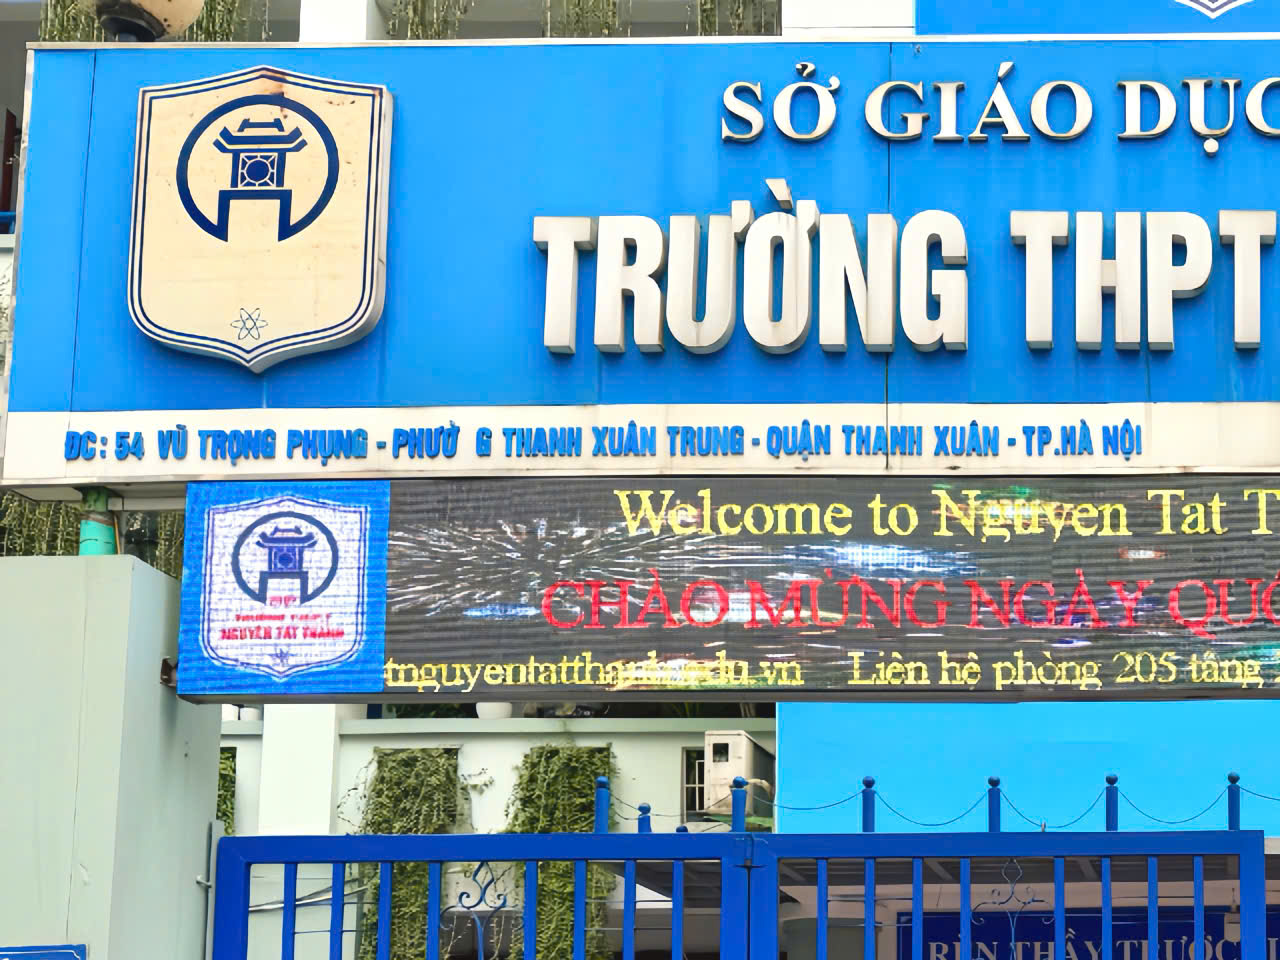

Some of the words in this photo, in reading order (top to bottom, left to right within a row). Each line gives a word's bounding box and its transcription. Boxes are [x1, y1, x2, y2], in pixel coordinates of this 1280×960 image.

[722, 62, 840, 143] SỞ
[865, 62, 1094, 142] GIÁO
[533, 178, 968, 355] TRƯỜNG
[1011, 209, 1277, 352] THPT
[115, 431, 145, 460] 54
[158, 424, 188, 460] VŨ
[199, 428, 276, 466] TRỌNG
[287, 428, 368, 466] PHỤNG
[502, 427, 582, 457] THANH
[592, 420, 657, 457] XUÂN
[667, 425, 744, 457] TRUNG
[766, 419, 831, 461] QUẬN
[842, 425, 923, 456] THANH
[934, 420, 999, 456] XUÂN
[1102, 418, 1142, 461] NỘI
[613, 488, 852, 536] Welcome
[868, 493, 919, 536] to
[932, 489, 1133, 542] Nguyen
[1147, 489, 1232, 536] Tat
[541, 568, 729, 629] CHÀO
[963, 568, 1155, 629] NGÀY
[992, 649, 1102, 690] phòng
[1113, 651, 1176, 684] 205
